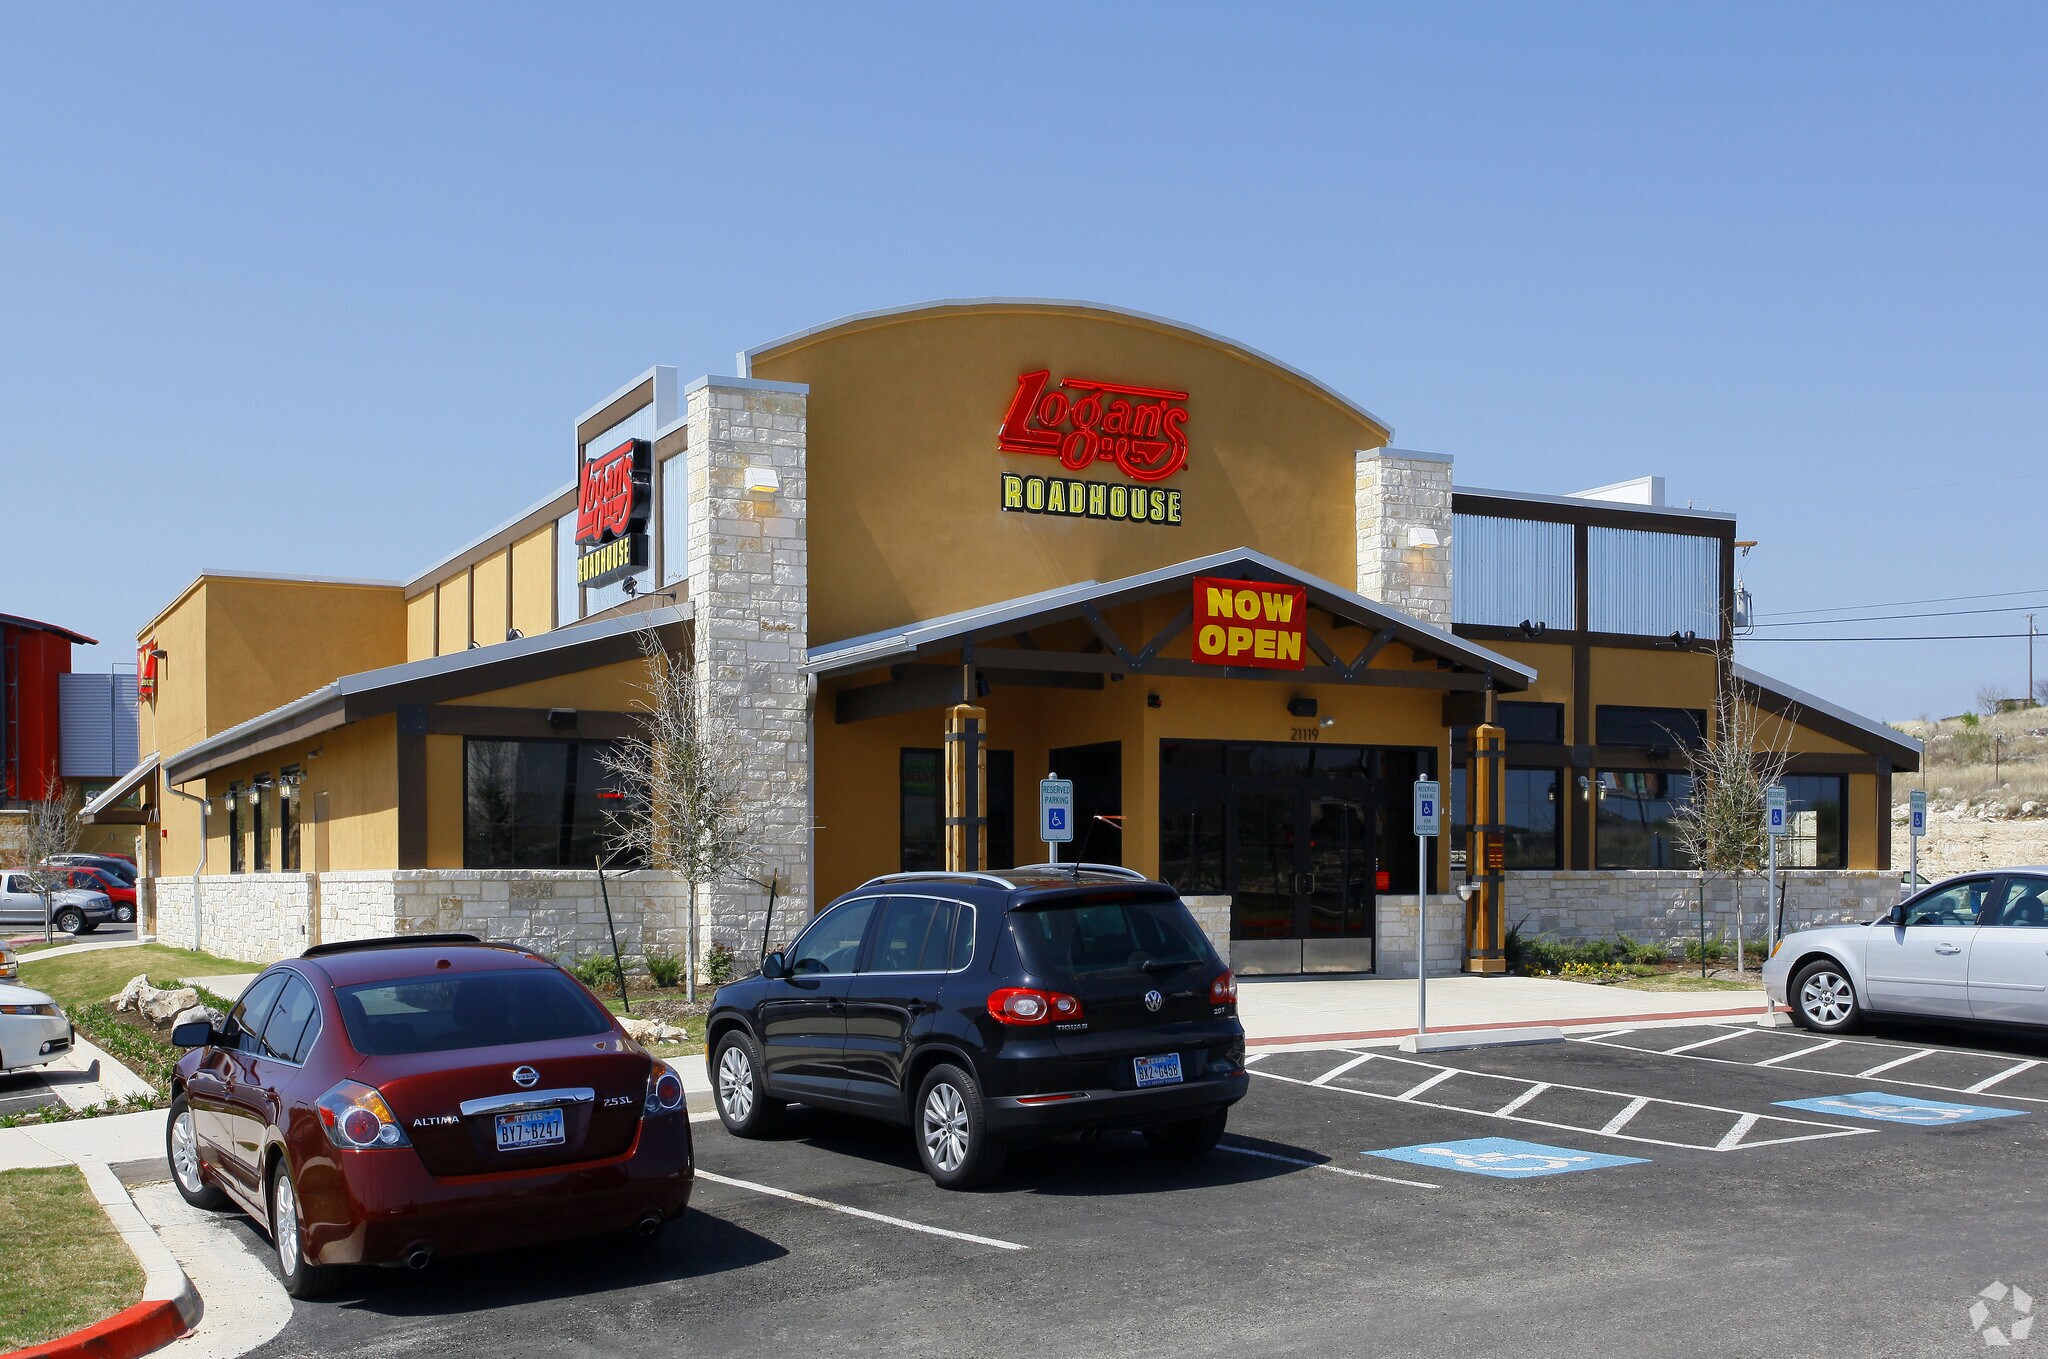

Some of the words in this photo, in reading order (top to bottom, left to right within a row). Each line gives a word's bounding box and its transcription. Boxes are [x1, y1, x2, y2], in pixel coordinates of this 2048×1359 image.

[998, 369, 1189, 482] Logan's
[575, 439, 634, 544] Logan's
[1001, 472, 1182, 526] ROADHOUSE
[578, 537, 630, 583] ROADHOUSE
[1206, 587, 1293, 623] NOW
[1198, 624, 1302, 661] OPEN
[1290, 727, 1319, 741] 21119
[1042, 785, 1070, 794] RESERVED
[1045, 796, 1069, 805] PARKING
[1147, 1056, 1166, 1064] TEXAS
[413, 1115, 460, 1127] ALTIMA
[514, 1112, 544, 1122] TEXAS
